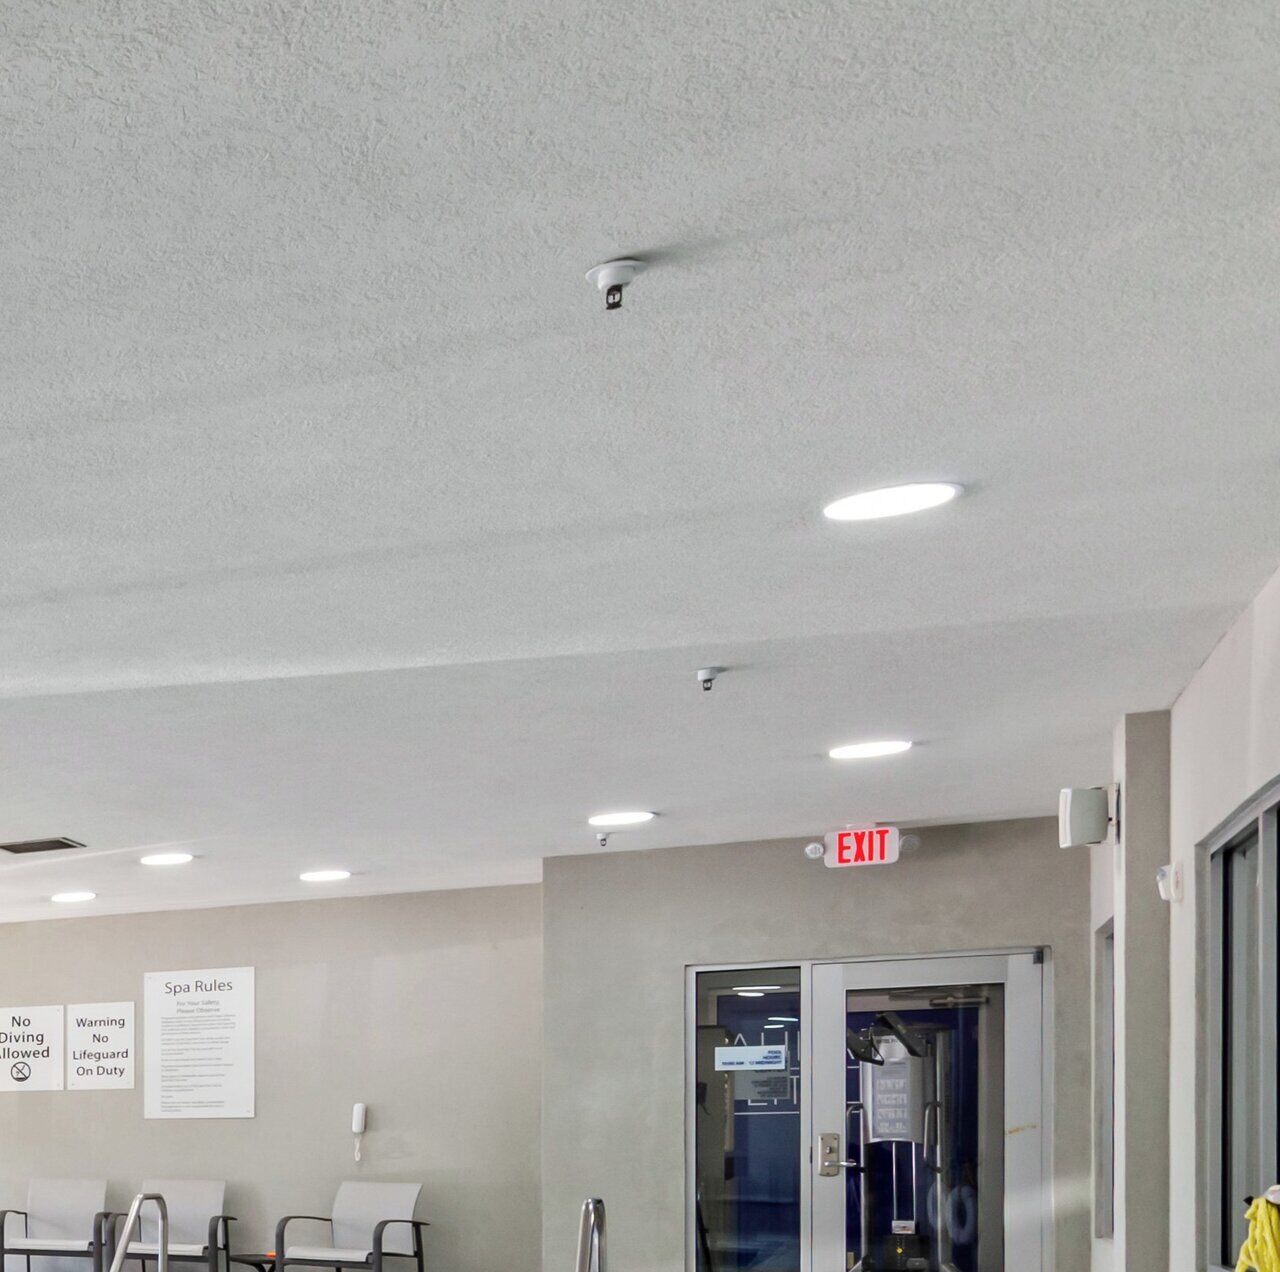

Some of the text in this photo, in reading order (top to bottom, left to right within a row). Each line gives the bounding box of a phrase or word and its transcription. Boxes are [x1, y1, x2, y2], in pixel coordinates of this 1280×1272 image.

[837, 829, 890, 864] EXIT
[164, 979, 233, 996] Spa Rules
[11, 1016, 31, 1027] No
[76, 1017, 126, 1029] Warning
[92, 1033, 109, 1043] No
[72, 1048, 129, 1062] Lifeguard
[76, 1066, 125, 1077] On Duty
